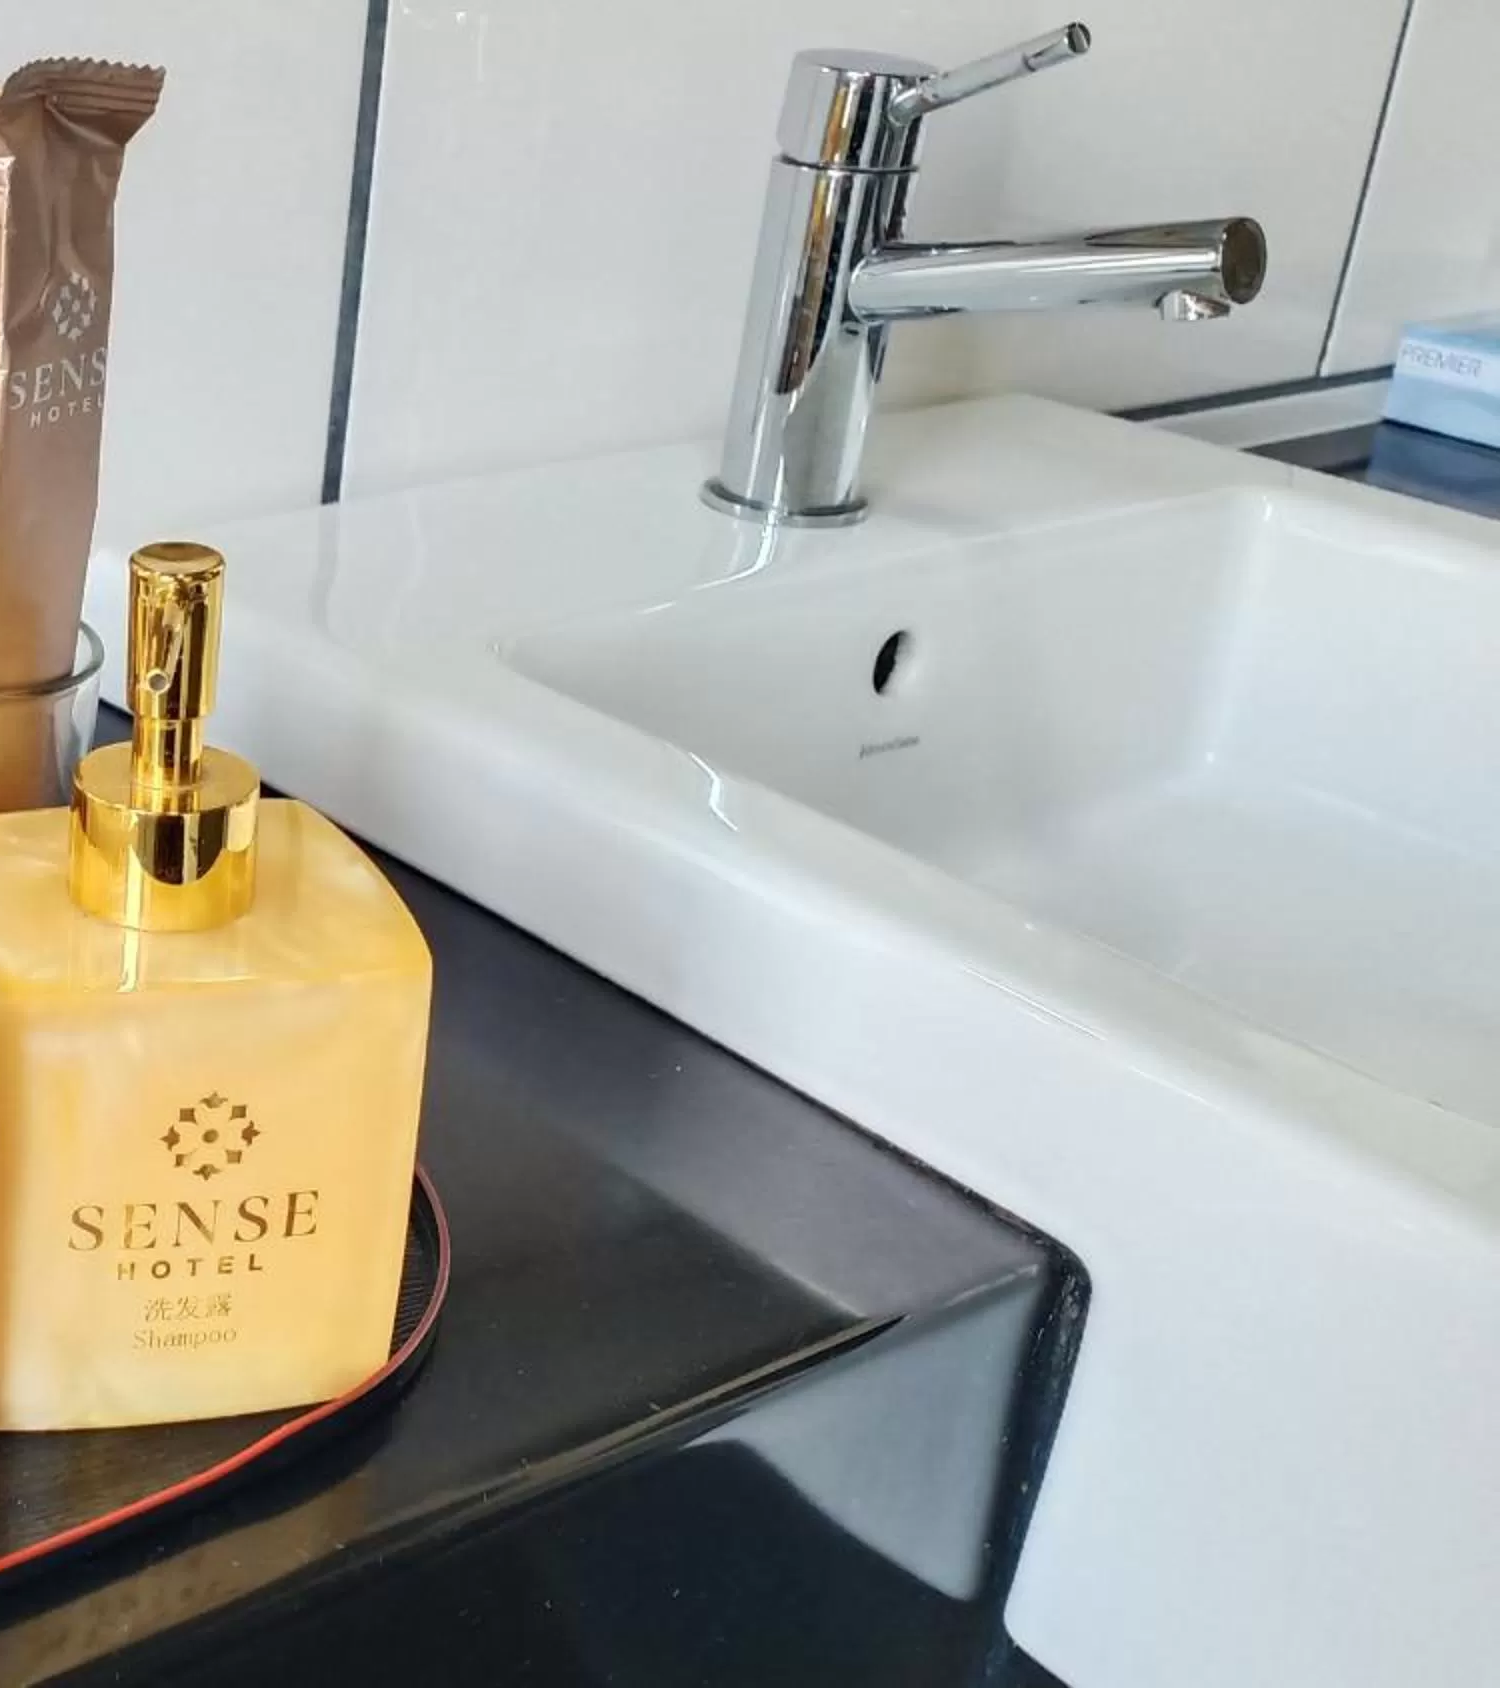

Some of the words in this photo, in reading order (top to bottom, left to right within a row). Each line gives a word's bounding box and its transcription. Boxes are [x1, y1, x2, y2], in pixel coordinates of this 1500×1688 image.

[8, 346, 107, 410] SENS
[67, 1189, 319, 1252] SENSE
[116, 1253, 264, 1281] HOTEL
[143, 1291, 234, 1322] 洗发露
[132, 1326, 238, 1350] Shampoo
